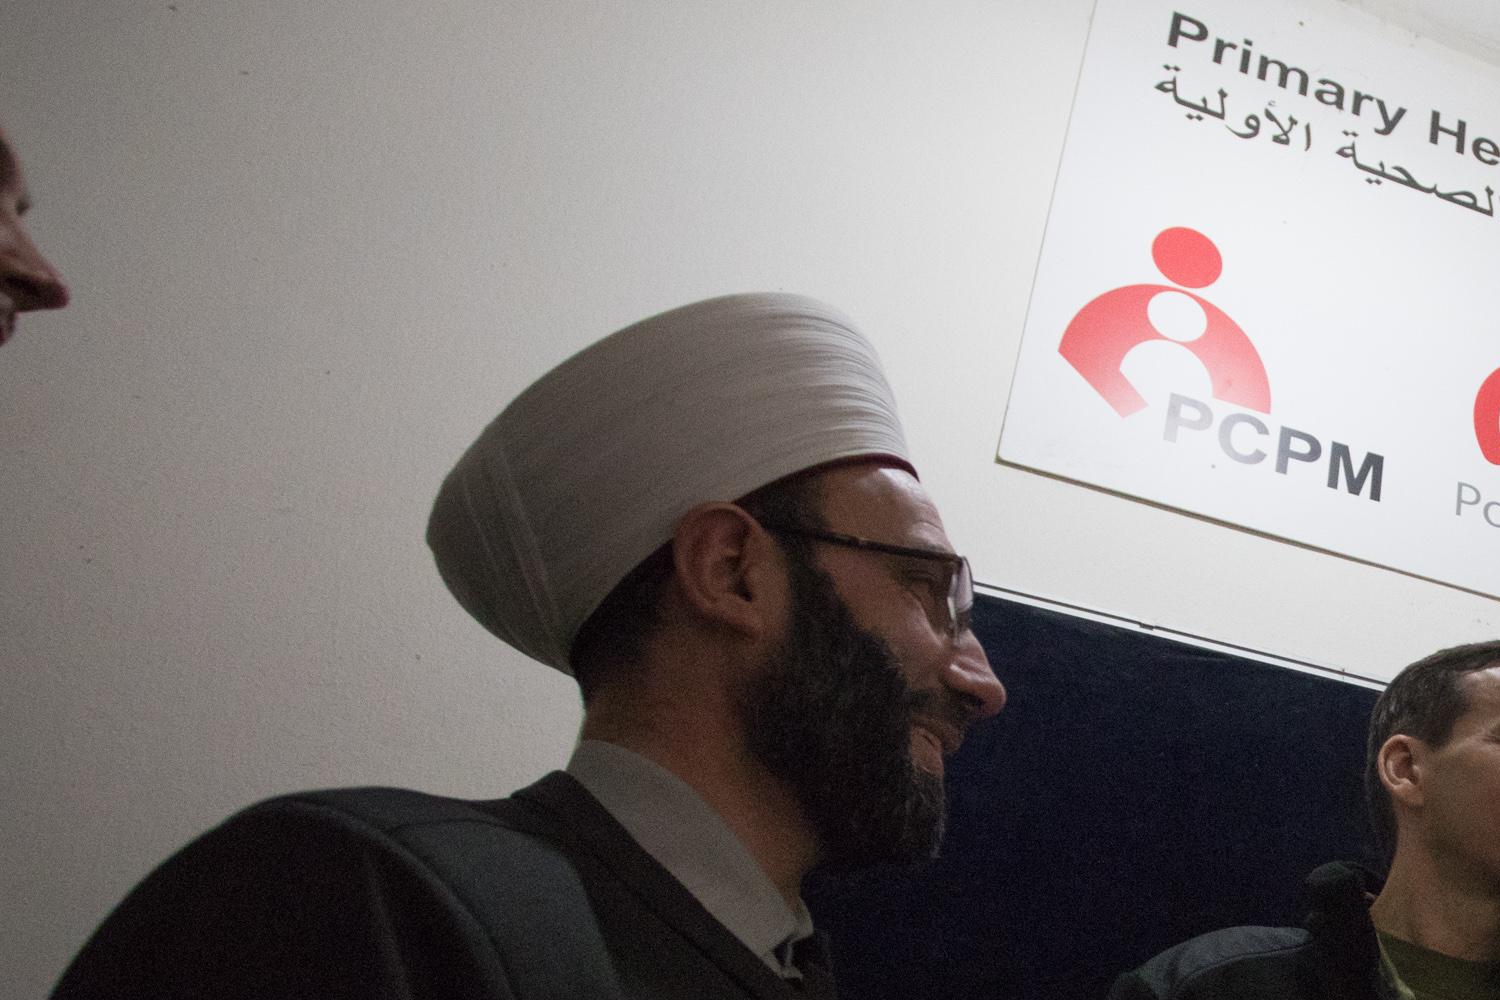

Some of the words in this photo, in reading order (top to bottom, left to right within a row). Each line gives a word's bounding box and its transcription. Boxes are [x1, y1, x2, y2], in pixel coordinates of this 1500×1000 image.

[1154, 63, 1311, 152] الأولية
[1167, 11, 1407, 136] Primary
[1162, 392, 1385, 502] PCPM
